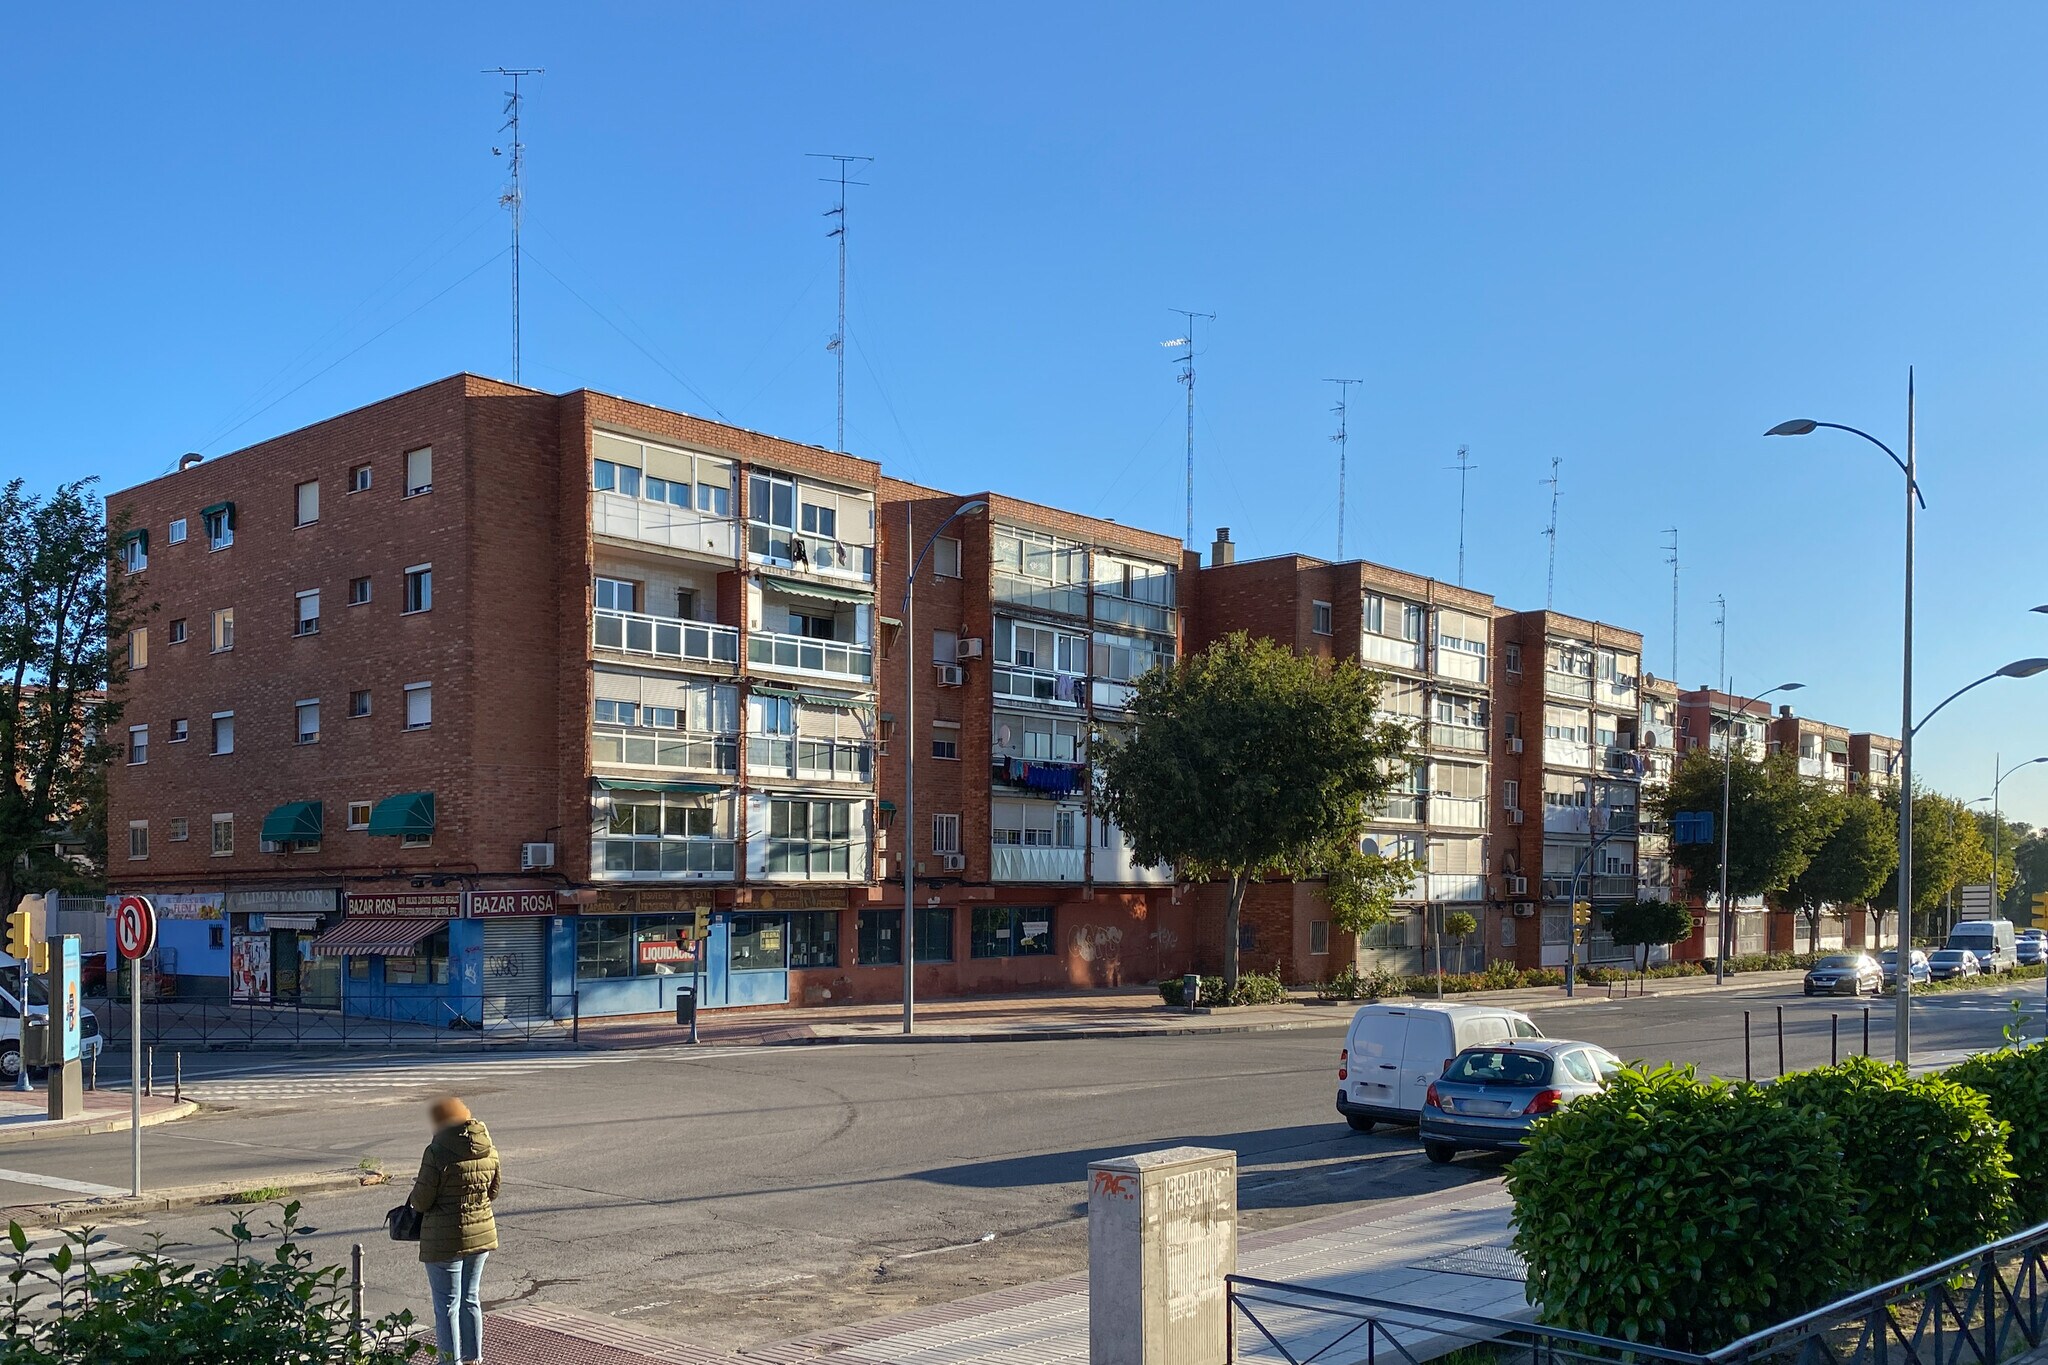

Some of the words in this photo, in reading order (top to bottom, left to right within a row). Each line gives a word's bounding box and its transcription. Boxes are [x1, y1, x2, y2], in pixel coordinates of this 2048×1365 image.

[239, 890, 323, 904] ALIMENTACION
[474, 896, 515, 914] BAZAR
[521, 895, 554, 912] ROSA
[348, 899, 374, 915] BAZAR
[375, 898, 397, 914] ROSA
[643, 943, 696, 961] LIQUIDACIÓ
